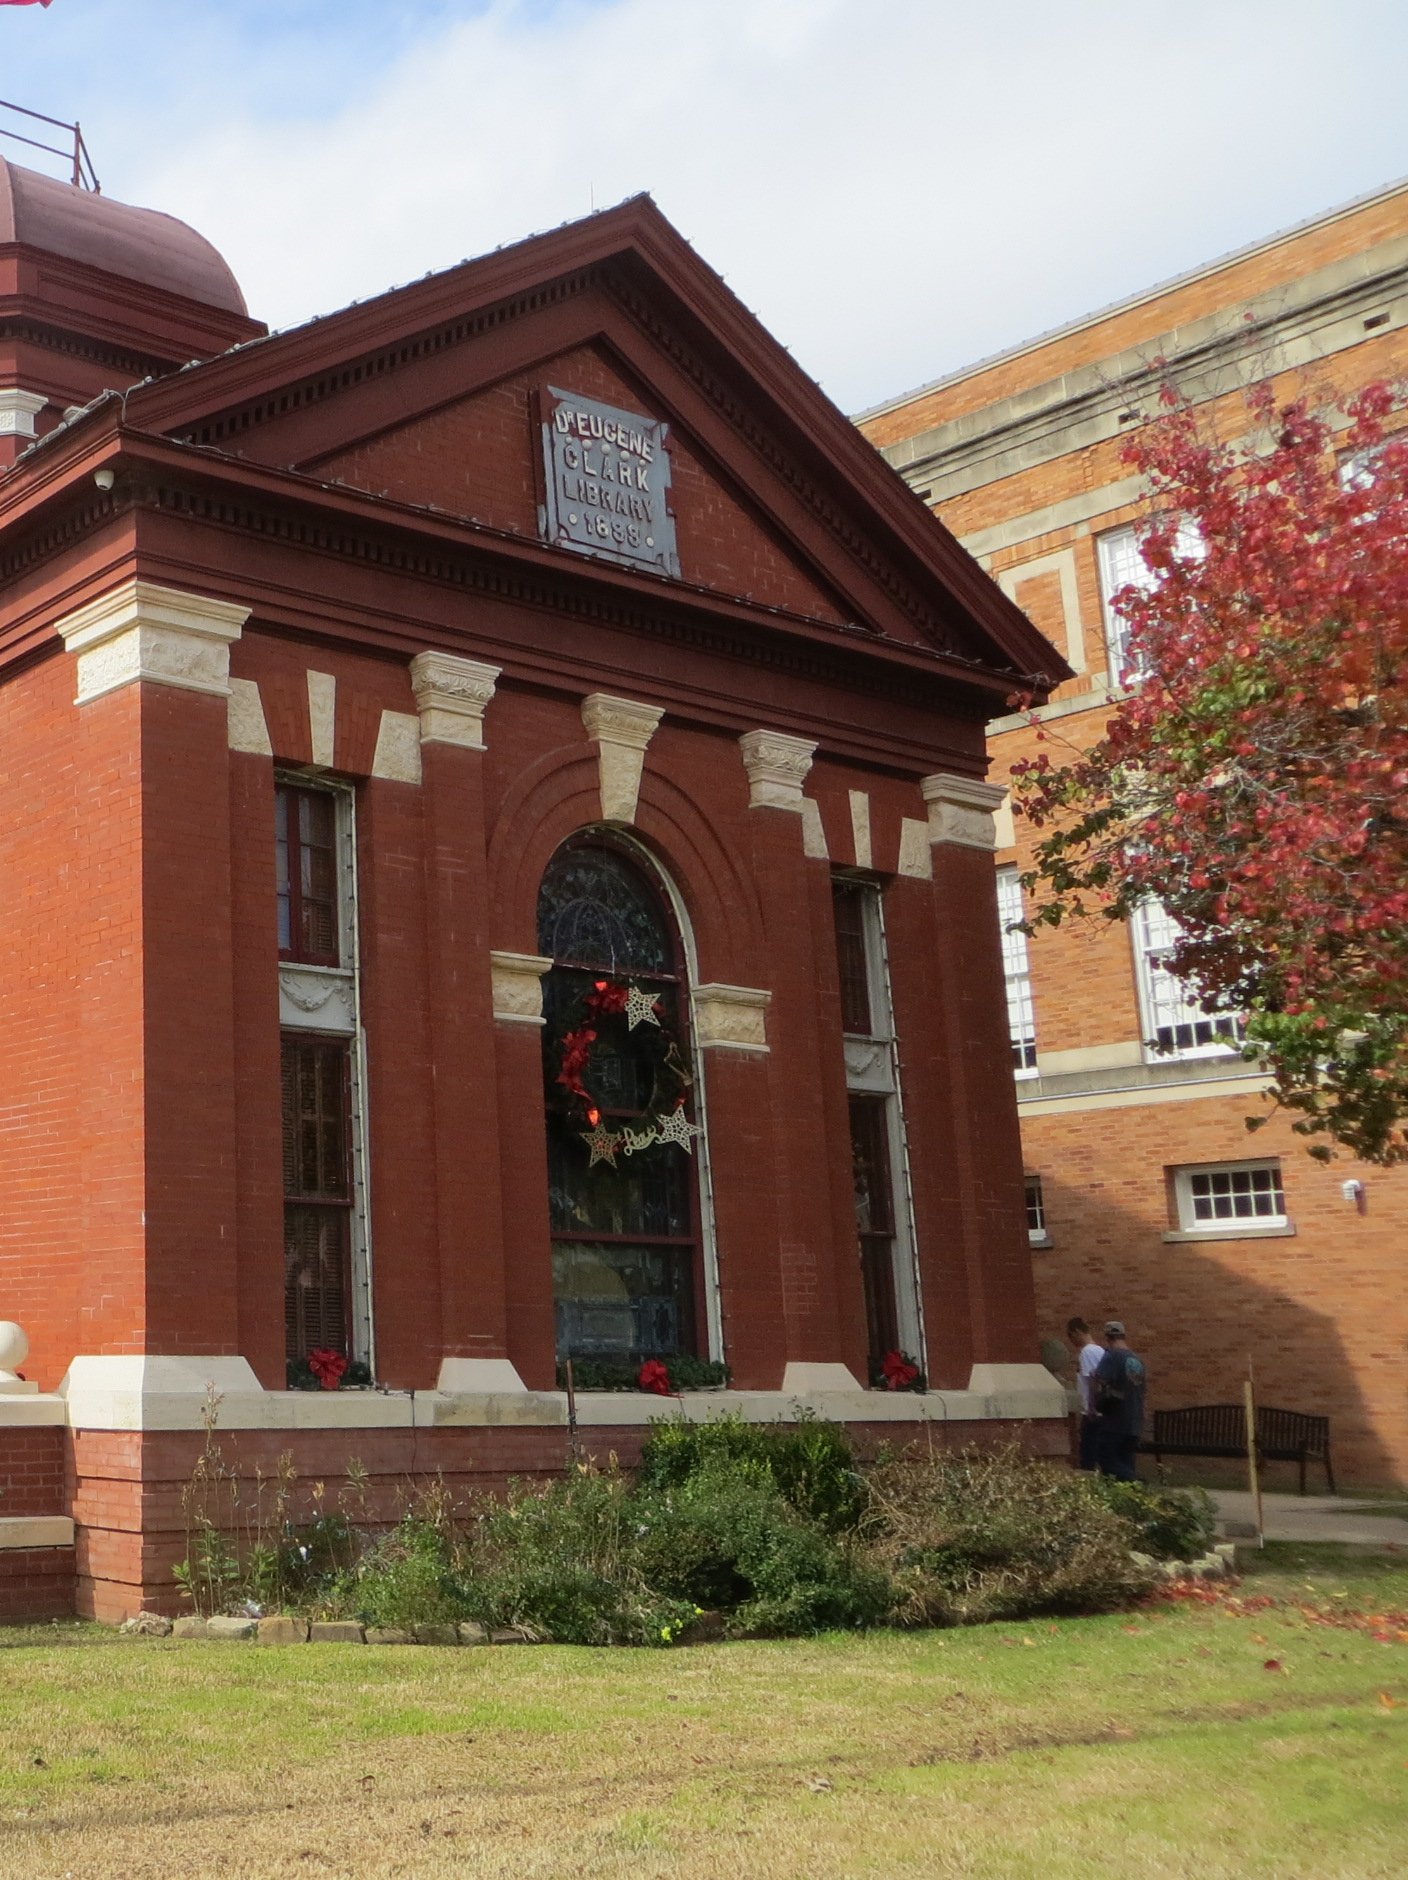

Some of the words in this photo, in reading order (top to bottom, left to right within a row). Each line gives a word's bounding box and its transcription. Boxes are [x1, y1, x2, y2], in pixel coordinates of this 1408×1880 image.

[576, 411, 653, 463] EUGENE
[564, 445, 650, 492] CLARK
[562, 475, 654, 522] LIBRARY
[584, 512, 641, 548] 1899
